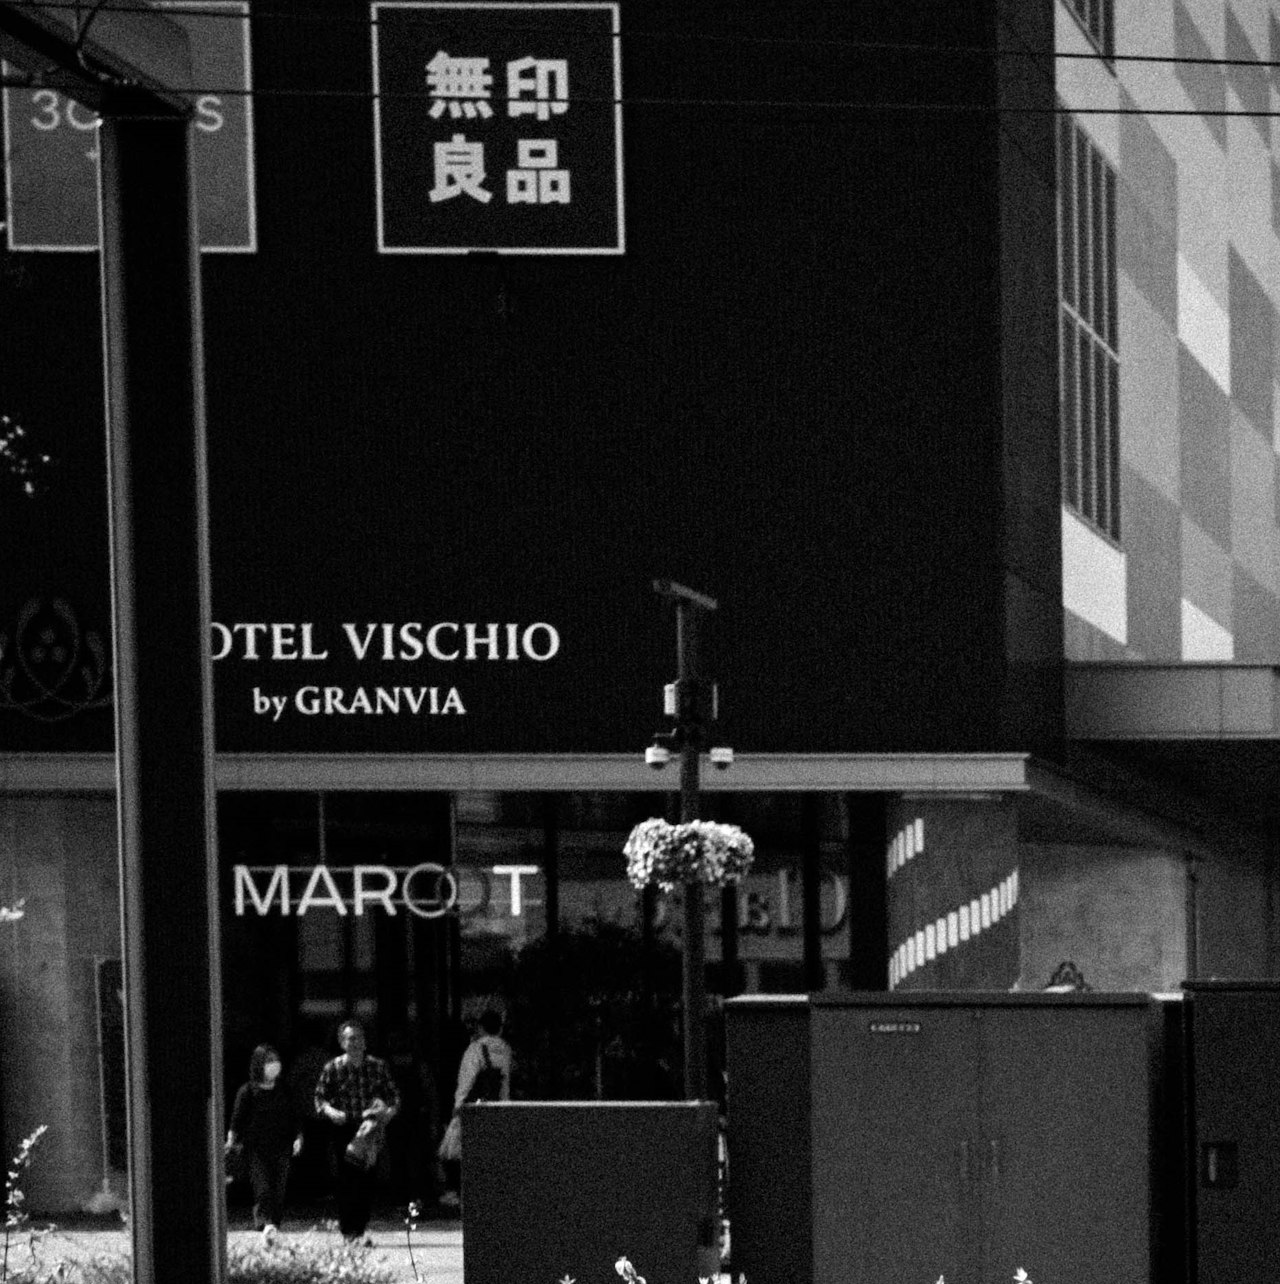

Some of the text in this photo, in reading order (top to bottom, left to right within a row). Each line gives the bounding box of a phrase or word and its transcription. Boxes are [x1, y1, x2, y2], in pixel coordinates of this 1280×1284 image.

[424, 51, 570, 121] 無印
[428, 133, 571, 204] 良品
[211, 621, 560, 661] OTEL VISCHIO
[252, 686, 467, 722] by GRANVIA
